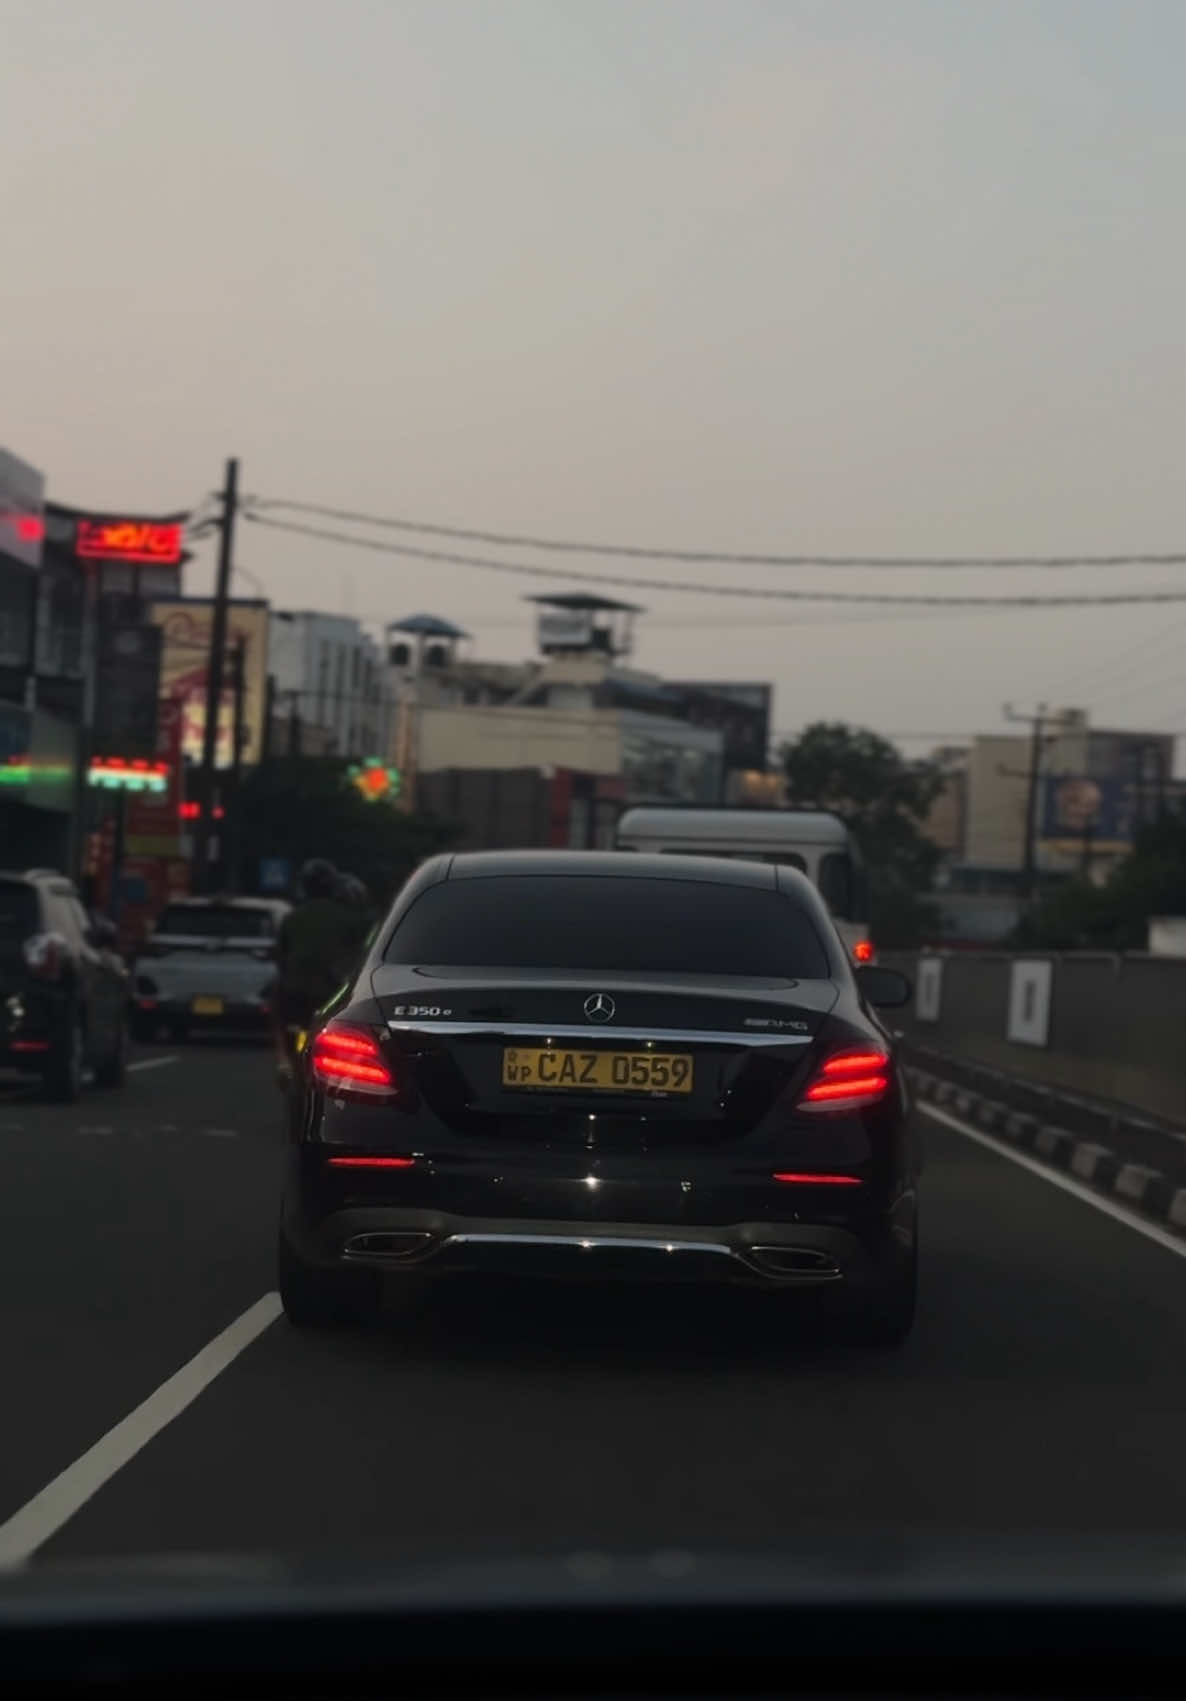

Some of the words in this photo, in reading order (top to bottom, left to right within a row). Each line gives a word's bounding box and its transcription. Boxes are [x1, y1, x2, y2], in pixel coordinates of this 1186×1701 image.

[394, 1005, 407, 1016] E
[408, 1005, 441, 1016] 350
[507, 1065, 532, 1082] WP
[538, 1053, 598, 1084] CAZ
[613, 1055, 689, 1087] 0559
